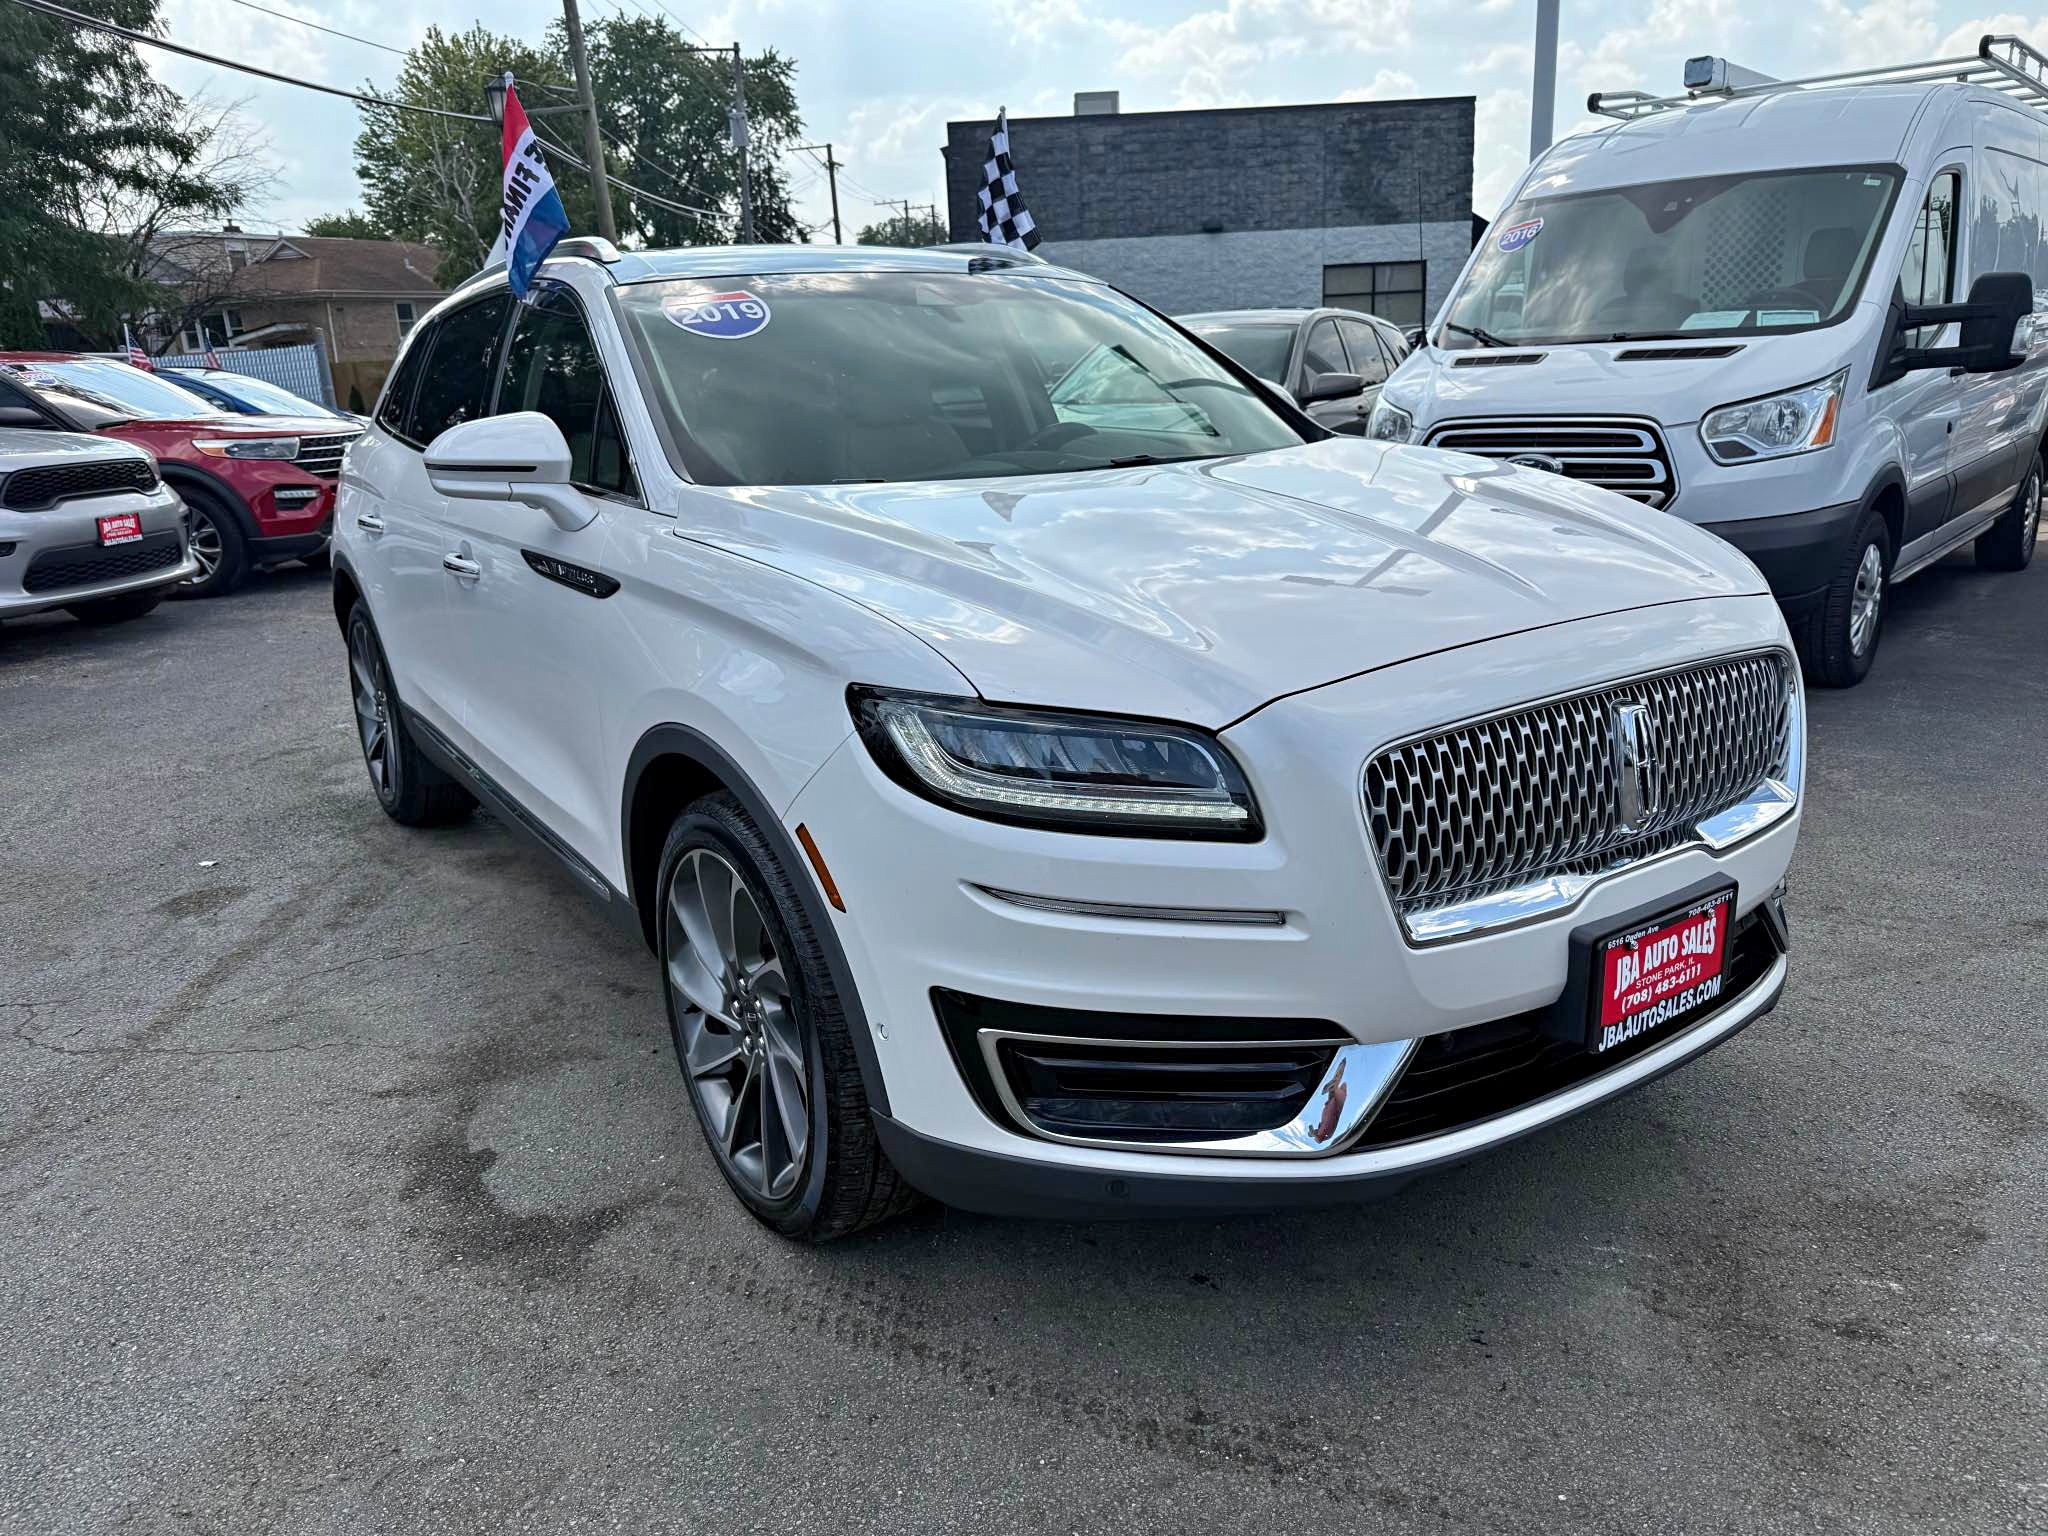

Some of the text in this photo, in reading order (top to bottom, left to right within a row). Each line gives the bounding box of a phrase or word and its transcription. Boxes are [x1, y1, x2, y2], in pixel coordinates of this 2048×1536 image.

[1500, 226, 1538, 246] 2016
[675, 302, 764, 324] 2019
[1688, 892, 1734, 918] 708-483-6111
[1608, 925, 1660, 949] 6516 Ogden Ave
[1613, 917, 1717, 1000] JBA AUTO SALES
[1621, 963, 1701, 1014] (708) 483-6111
[1635, 971, 1663, 989] STONE
[1664, 962, 1687, 977] PARK,
[1598, 974, 1722, 1052] JBAAUTOSALES.COM
